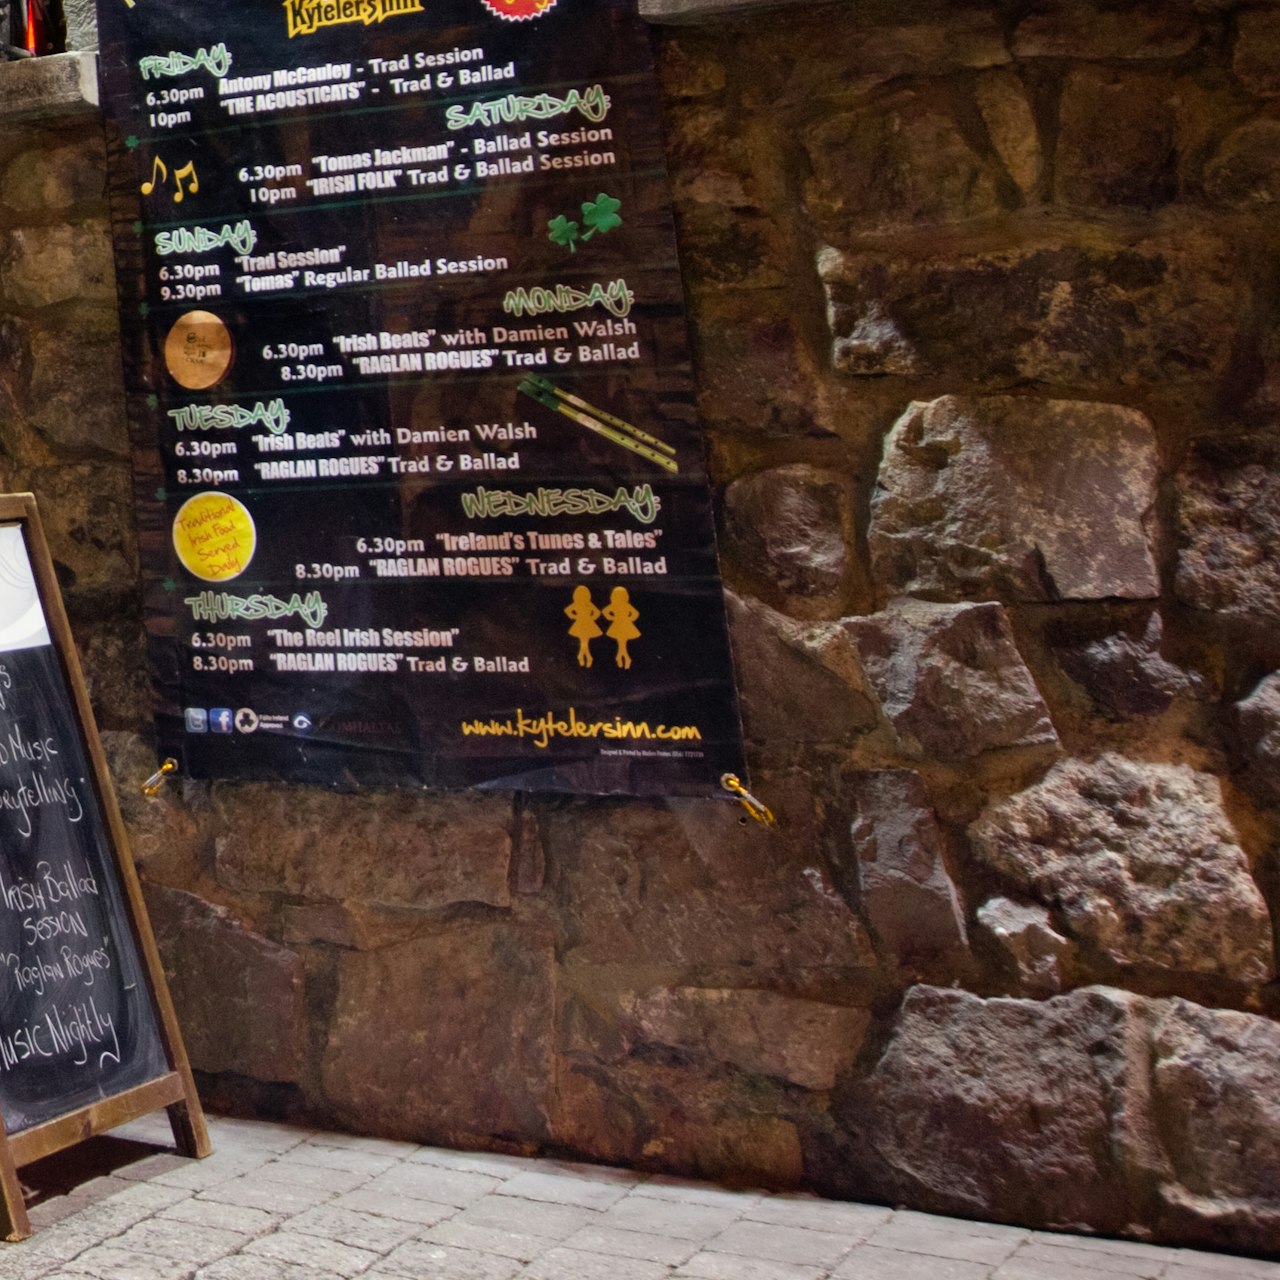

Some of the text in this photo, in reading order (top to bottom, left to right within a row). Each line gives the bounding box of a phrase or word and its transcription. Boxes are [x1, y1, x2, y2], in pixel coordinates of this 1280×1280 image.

[146, 85, 205, 107] 6.30pm
[218, 76, 273, 96] Antony
[274, 62, 352, 88] McCauley
[368, 54, 410, 74] Trad
[415, 46, 484, 69] Session
[149, 108, 192, 128] 10pm
[390, 74, 432, 94] Trad
[436, 72, 454, 88] &
[459, 61, 515, 86] Ballad
[238, 163, 302, 184] 6.30pm
[474, 132, 532, 155] Ballad
[536, 127, 614, 148] Session
[249, 186, 297, 204] 10pm
[407, 166, 449, 186] Trad
[453, 164, 471, 179] &
[475, 155, 534, 178] Ballad
[539, 150, 616, 171] Session
[158, 263, 221, 282] 6.30pm
[160, 283, 222, 301] 9.30pm
[304, 266, 370, 289] Regular
[374, 260, 431, 280] Ballad
[436, 255, 509, 275] Session
[262, 342, 325, 361] 6.30pm
[441, 327, 487, 347] with
[493, 324, 569, 344] Damien
[572, 318, 637, 338] Walsh
[280, 363, 344, 381] 8.30pm
[502, 347, 548, 367] Trad
[553, 347, 572, 363] &
[578, 342, 641, 363] Ballad
[175, 441, 237, 459] 6.30pm
[350, 428, 391, 446] with
[396, 425, 471, 444] Damien
[474, 422, 538, 440] Walsh
[177, 468, 240, 486] 8.30pm
[387, 455, 430, 474] Trad
[435, 454, 454, 470] &
[459, 452, 521, 470] Ballad
[177, 497, 236, 531] Traditional
[197, 536, 240, 561] Served
[356, 537, 425, 555] 6.30pm
[526, 531, 585, 550] Tunes
[587, 532, 602, 549] &
[295, 563, 360, 581] 8.30pm
[525, 557, 571, 575] Trad
[577, 557, 596, 574] &
[603, 556, 668, 575] Ballad
[191, 631, 252, 650] 6.30pm
[305, 628, 340, 647] Reel
[343, 628, 381, 647] Irish
[192, 655, 254, 674] 8.30pm
[406, 656, 446, 672] Trad
[451, 656, 469, 671] &
[474, 656, 530, 672] Ballad
[462, 707, 702, 748] www.kytelersinn.com
